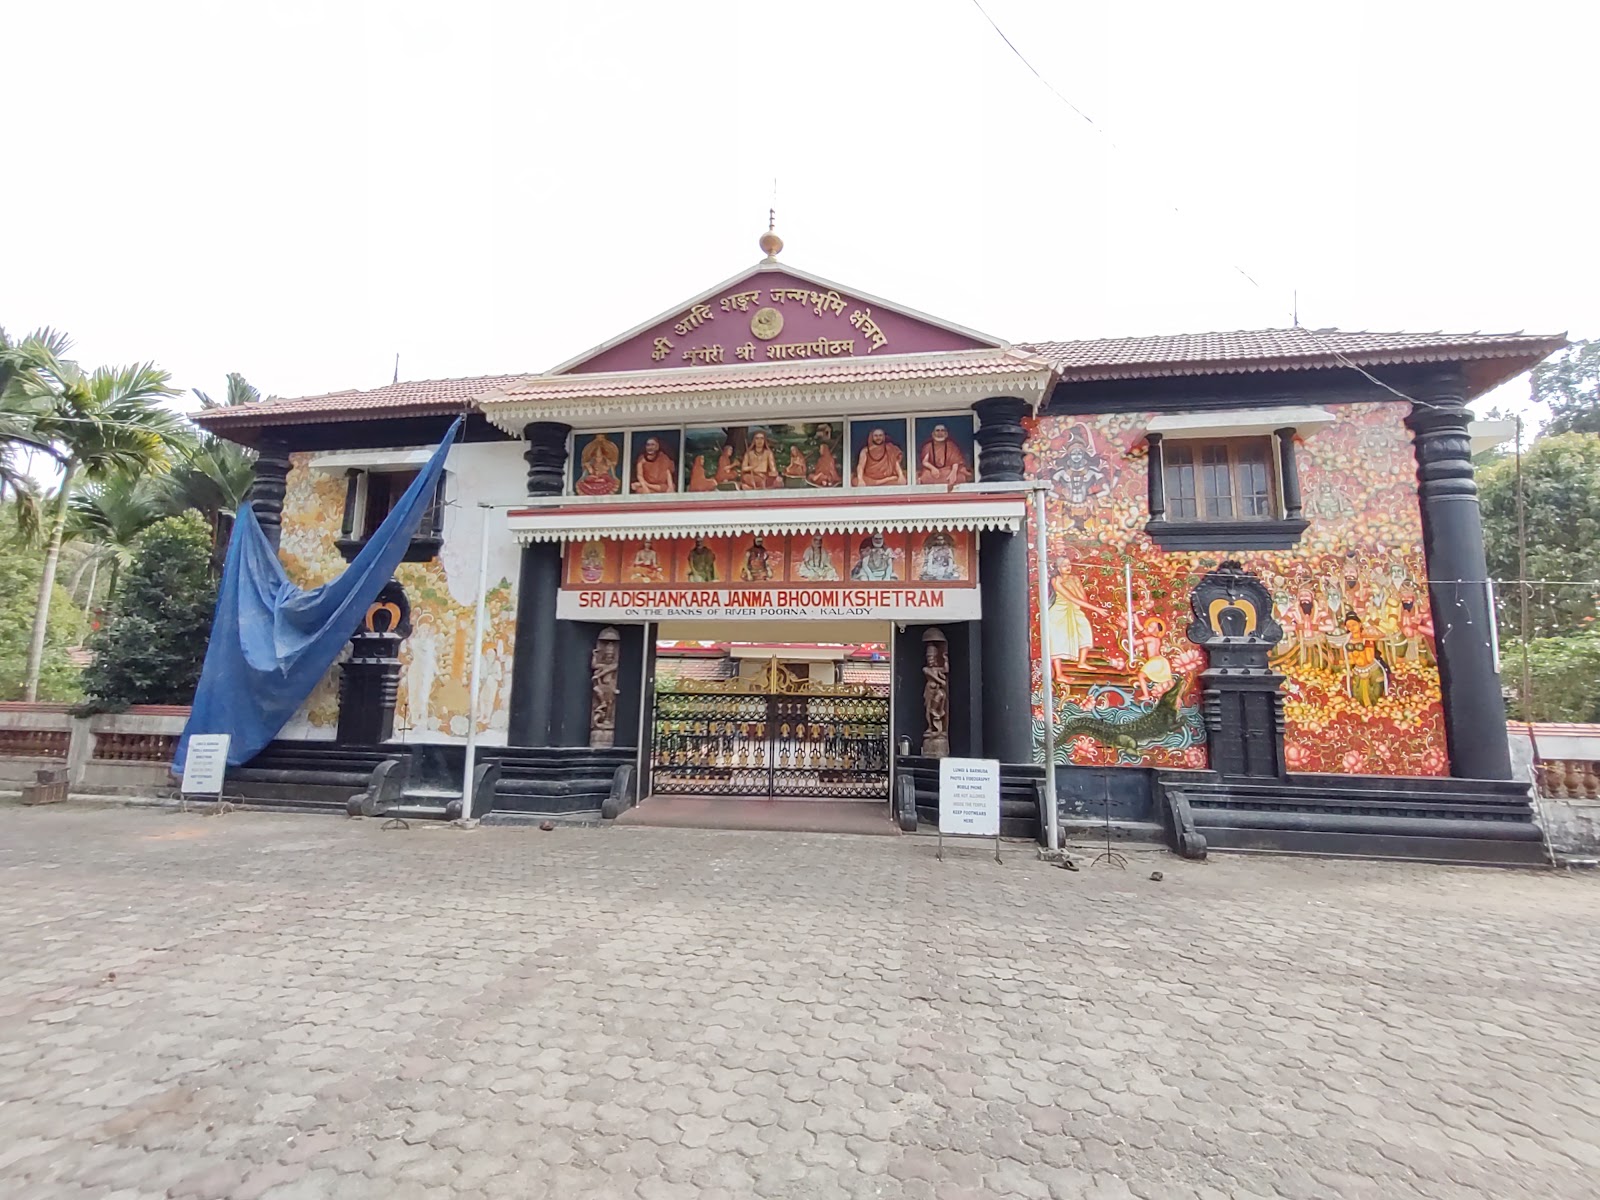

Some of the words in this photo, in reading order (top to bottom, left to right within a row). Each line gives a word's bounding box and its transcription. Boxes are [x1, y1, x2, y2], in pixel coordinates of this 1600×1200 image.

[651, 336, 675, 361] श्री
[674, 304, 714, 335] आदि
[770, 288, 848, 317] जन्मभूमि
[849, 307, 889, 354] क्षेत्रम्
[735, 341, 757, 361] श्री
[766, 337, 855, 360] शारदापीठम्
[579, 591, 606, 608] SRI
[608, 591, 721, 608] ADISHANKARA
[724, 591, 774, 608] JANMA
[777, 590, 839, 607] BHOOMI
[842, 590, 944, 608] KSHETRAM
[625, 608, 640, 616] ON
[643, 608, 663, 616] THE
[667, 608, 703, 616] BANKS
[707, 608, 721, 616] OF
[725, 608, 756, 616] RIVER
[760, 608, 808, 616] POORNA
[820, 607, 873, 616] KALADY
